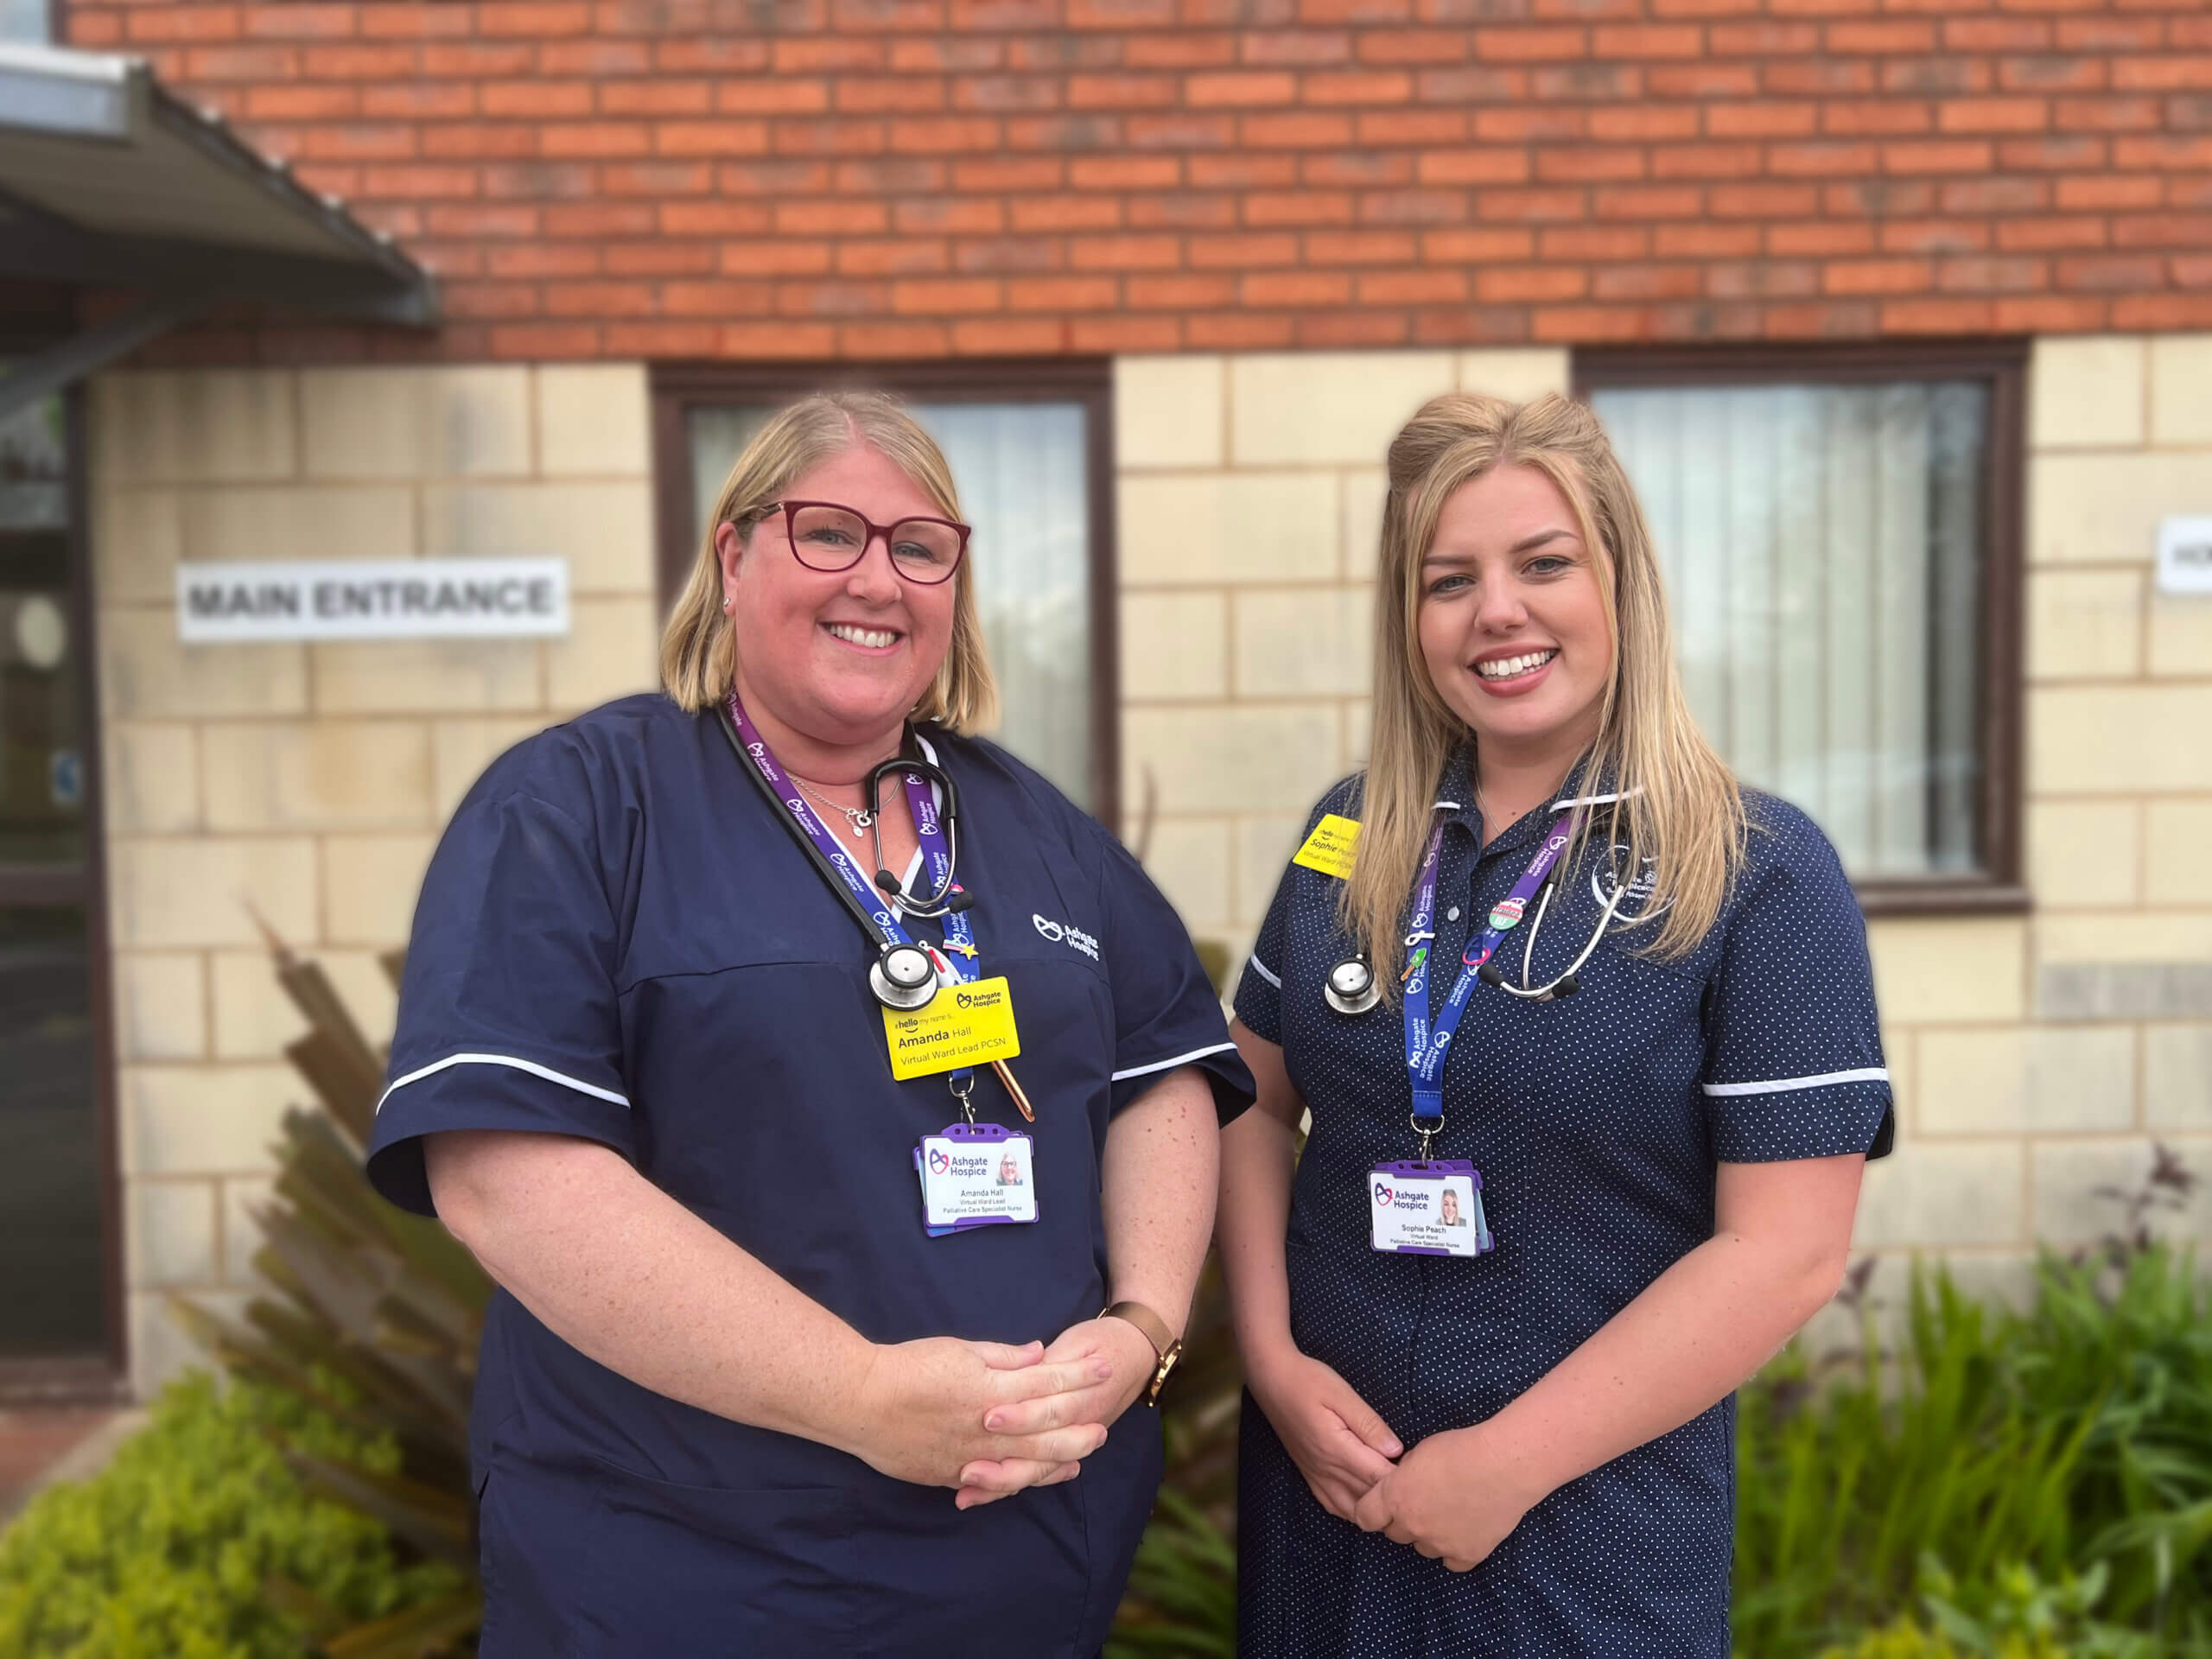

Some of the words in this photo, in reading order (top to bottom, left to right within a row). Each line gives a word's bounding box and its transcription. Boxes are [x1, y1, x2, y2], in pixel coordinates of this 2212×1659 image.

[188, 583, 299, 620] MAIN
[313, 578, 551, 619] ENTRANCE
[759, 757, 779, 781] Ashgate
[918, 800, 929, 823] Ashgate
[799, 812, 821, 836] Ashgate
[1310, 838, 1338, 852] Sophie
[933, 851, 944, 875] Ashgate
[1527, 848, 1549, 874] Hospice
[1532, 850, 1554, 878] Ashgate
[836, 865, 858, 891] Hospice
[843, 867, 864, 893] Ashgate
[1065, 925, 1099, 949] Ashgate
[1066, 934, 1099, 961] Hospice
[973, 991, 1001, 1002] Ashgate
[1449, 974, 1468, 1004] Hospice
[1452, 976, 1471, 1007] Ashgate
[973, 998, 1001, 1008] Hospice
[899, 1029, 950, 1049] Amanda
[952, 1026, 972, 1038] Hall
[1412, 1018, 1421, 1050] Ashgate
[1420, 1019, 1428, 1051] Hospice
[900, 1053, 931, 1065] Virtual
[932, 1047, 956, 1060] Ward
[958, 1041, 979, 1054] Lead
[981, 1037, 1007, 1050] PCSN
[1419, 1046, 1435, 1079] Hospice
[1426, 1049, 1440, 1082] Ashgate
[950, 1166, 987, 1178] Hospice
[951, 1156, 988, 1168] Ashgate
[990, 1188, 1004, 1197] Hall
[1395, 1191, 1430, 1202] Ashgate
[1394, 1200, 1428, 1211] Hospice
[1402, 1224, 1425, 1233] Sophie
[1426, 1225, 1446, 1234] Peach
